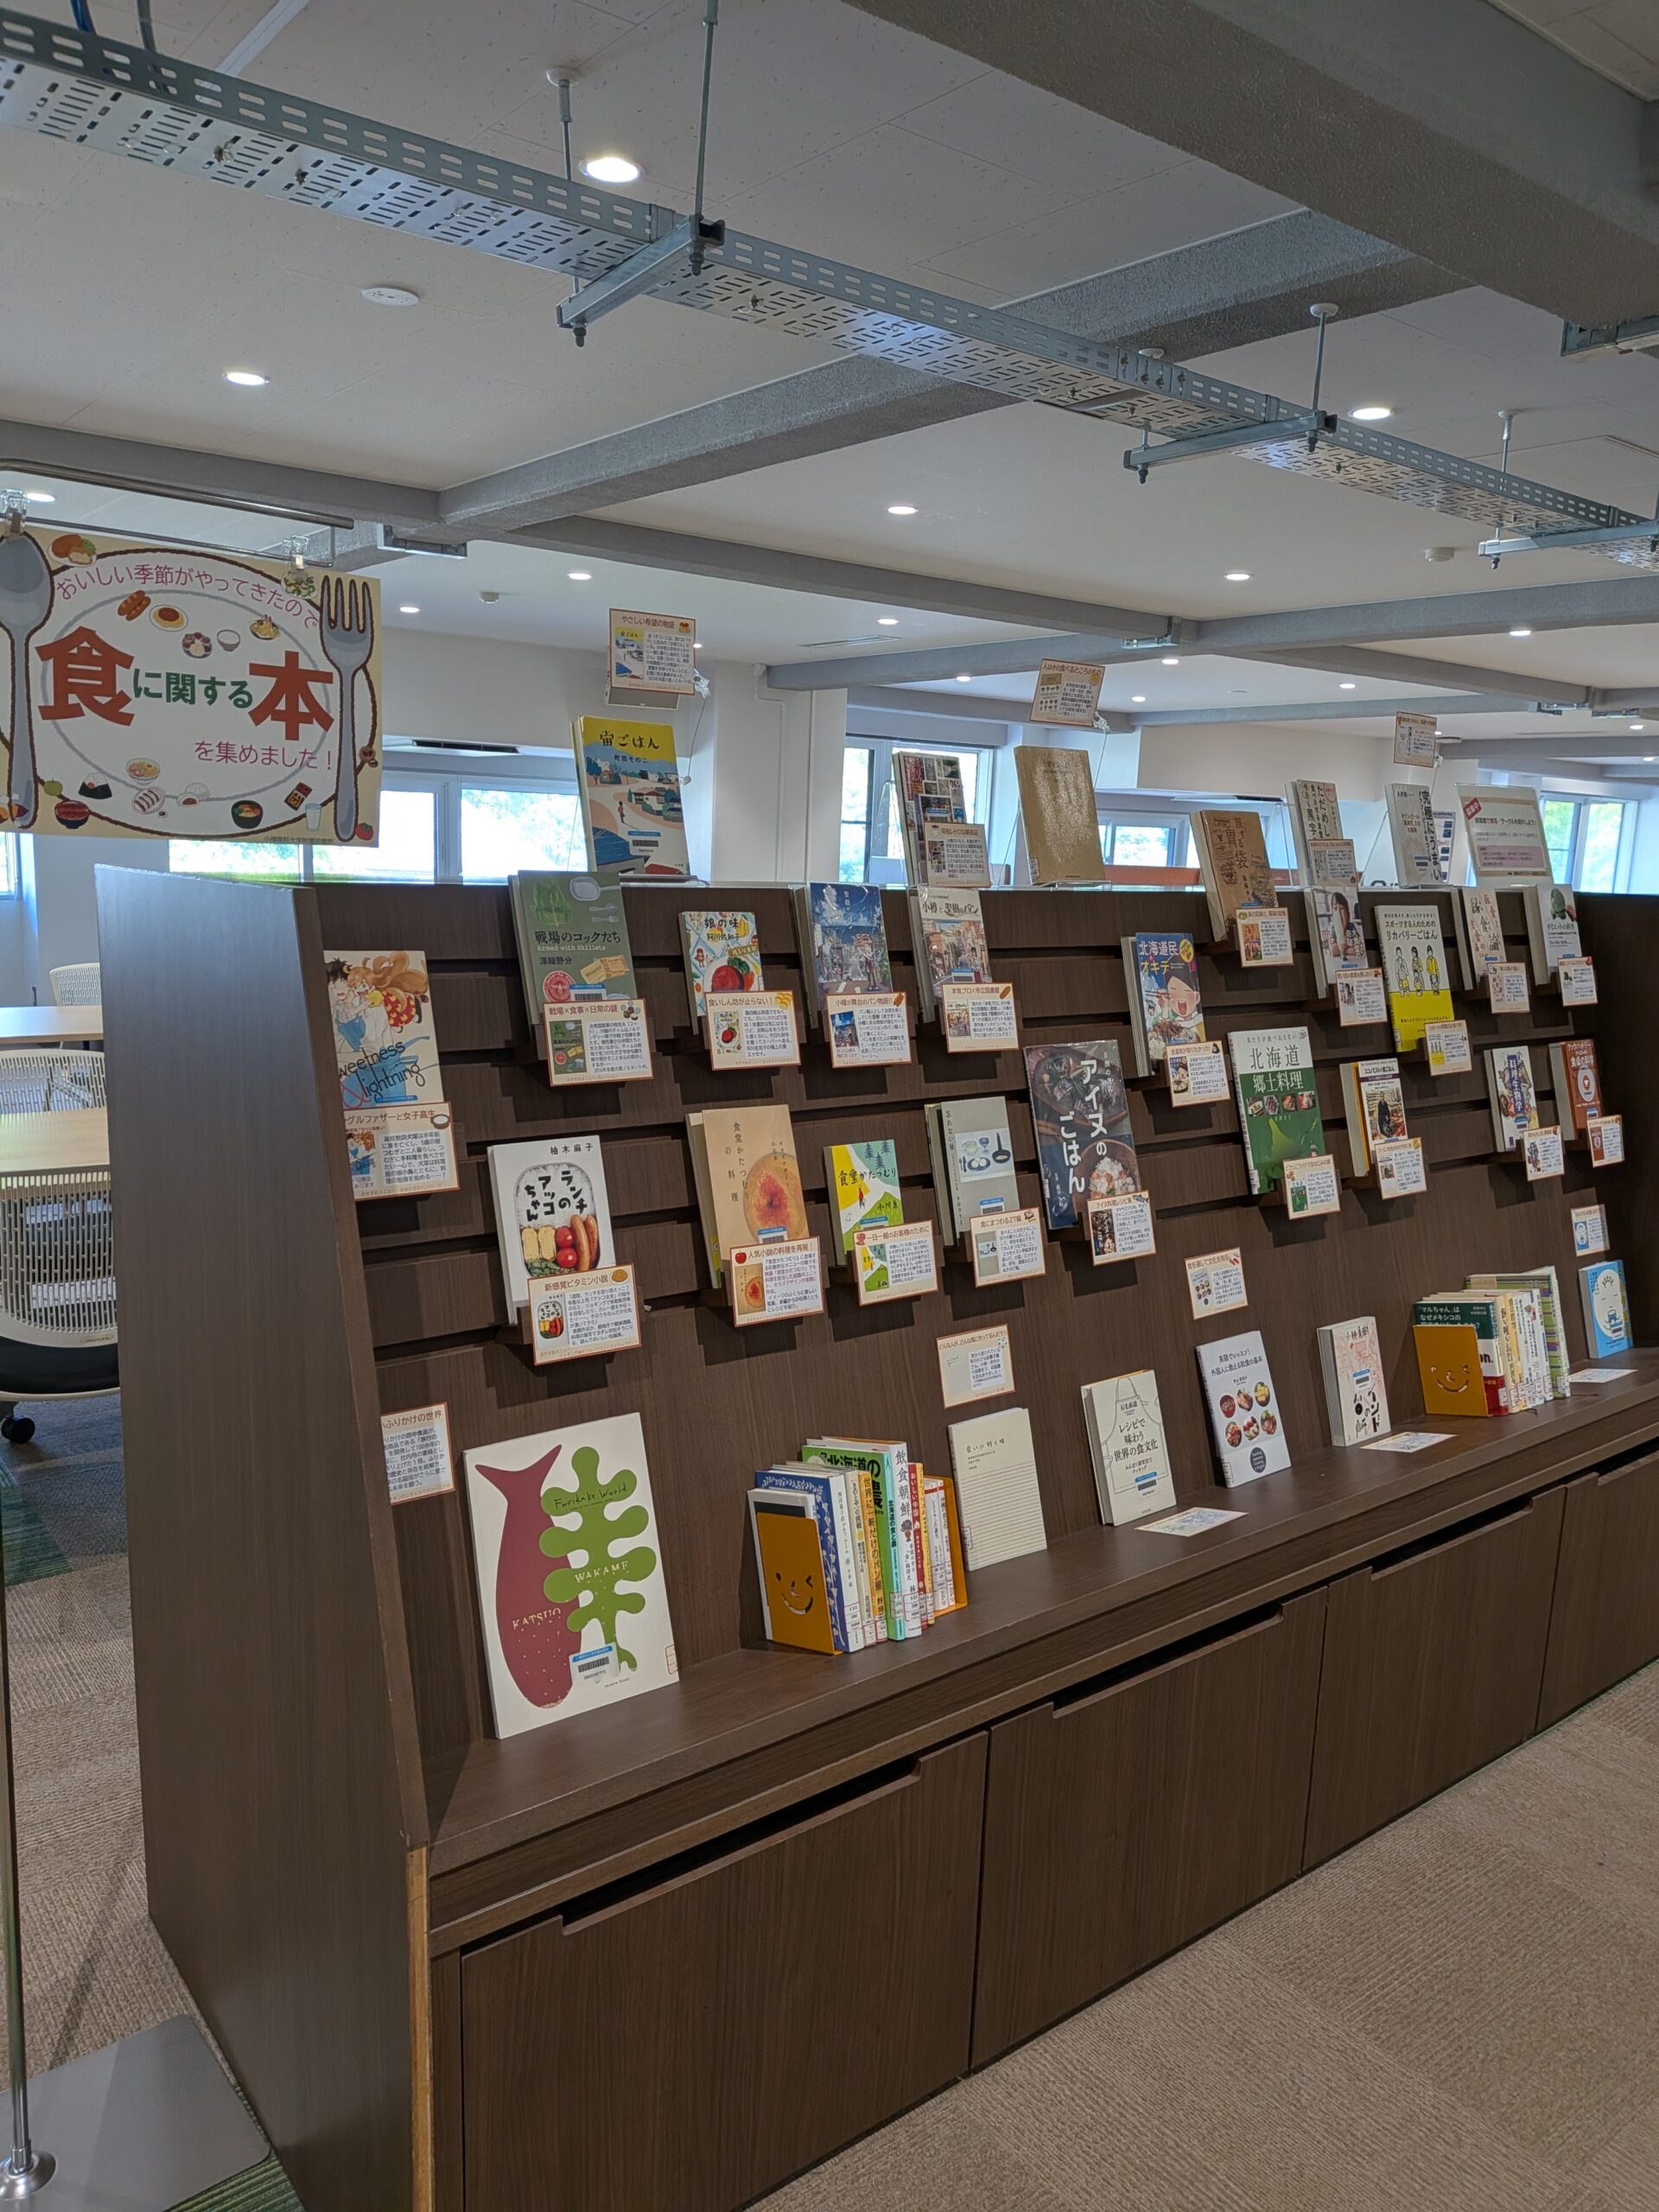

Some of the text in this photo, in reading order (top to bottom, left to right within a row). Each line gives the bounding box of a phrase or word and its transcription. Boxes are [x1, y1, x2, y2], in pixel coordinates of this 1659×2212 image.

[57, 563, 320, 628] おいしい季節がやってきたので
[622, 615, 674, 629] やさしい希望の物語
[35, 626, 334, 741] 食に関する本
[600, 730, 659, 749] 宙ごはん
[194, 741, 332, 770] を集めました！
[614, 755, 647, 764] 町田そのこ
[705, 918, 739, 928] 娘の味
[535, 931, 620, 944] 戦場のコックたち
[1386, 930, 1438, 941] リカバリーごはん
[1139, 941, 1179, 956] 北海道民
[540, 957, 572, 965] 深緑野分
[1141, 961, 1169, 975] オキテ
[548, 1003, 618, 1016] 戦場×食事×日常の謎
[709, 997, 772, 1006] 食いしん坊が止らない！
[1249, 1045, 1300, 1070] 北海道
[355, 1061, 425, 1104] lightning
[1253, 1071, 1303, 1094] 郷土料理
[1081, 1059, 1108, 1156] アイヌの
[550, 1143, 594, 1155] 柚木麻子
[1060, 1111, 1085, 1193] ごはん
[734, 1122, 749, 1201] 食堂かたつむり
[725, 1147, 739, 1203] の料理
[839, 1168, 896, 1186] 食堂かたつむり
[878, 1200, 899, 1211] 小川糸
[867, 1225, 929, 1242] 一日一組のお客様のために
[747, 1243, 812, 1259] 人気小説の料理を再現！
[1187, 1254, 1229, 1269] 食を通して文化を知る
[544, 1274, 608, 1292] 新感覚ビタミン小説
[1218, 1347, 1251, 1363] 英語でレッスン！
[1211, 1355, 1263, 1377] 外国人に教える和食の基本
[1120, 1401, 1138, 1411] 石毛直道
[1119, 1418, 1145, 1433] レシピで
[1123, 1431, 1144, 1445] 味わう
[1114, 1440, 1159, 1462] 世界の食文化
[895, 1449, 911, 1517] 飲食朝鮮
[554, 1483, 627, 1511] Furikake World
[864, 1477, 883, 1591] 世界に一軒だけのパン屋
[575, 1560, 628, 1584] WAKAME
[512, 1607, 562, 1630] KATSUO
